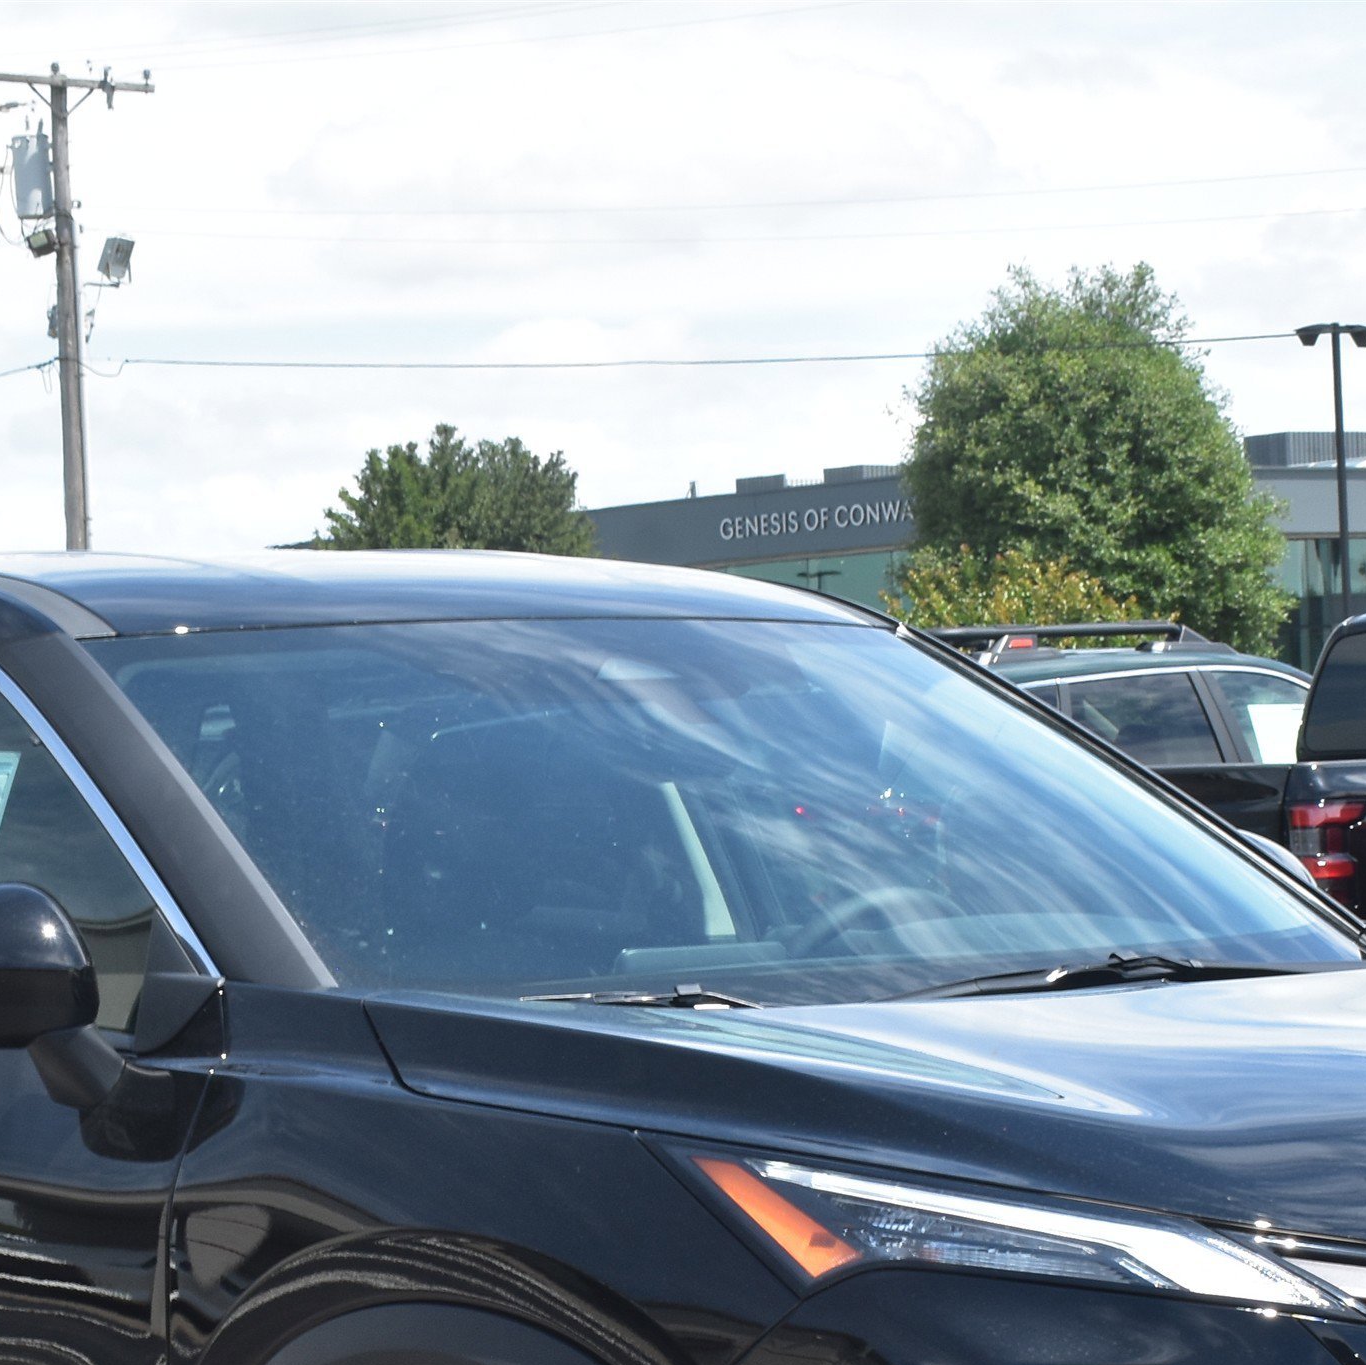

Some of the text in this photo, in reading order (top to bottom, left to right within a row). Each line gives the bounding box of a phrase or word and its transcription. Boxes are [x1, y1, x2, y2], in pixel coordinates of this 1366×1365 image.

[720, 499, 915, 540] GENESIS OF CONWA
